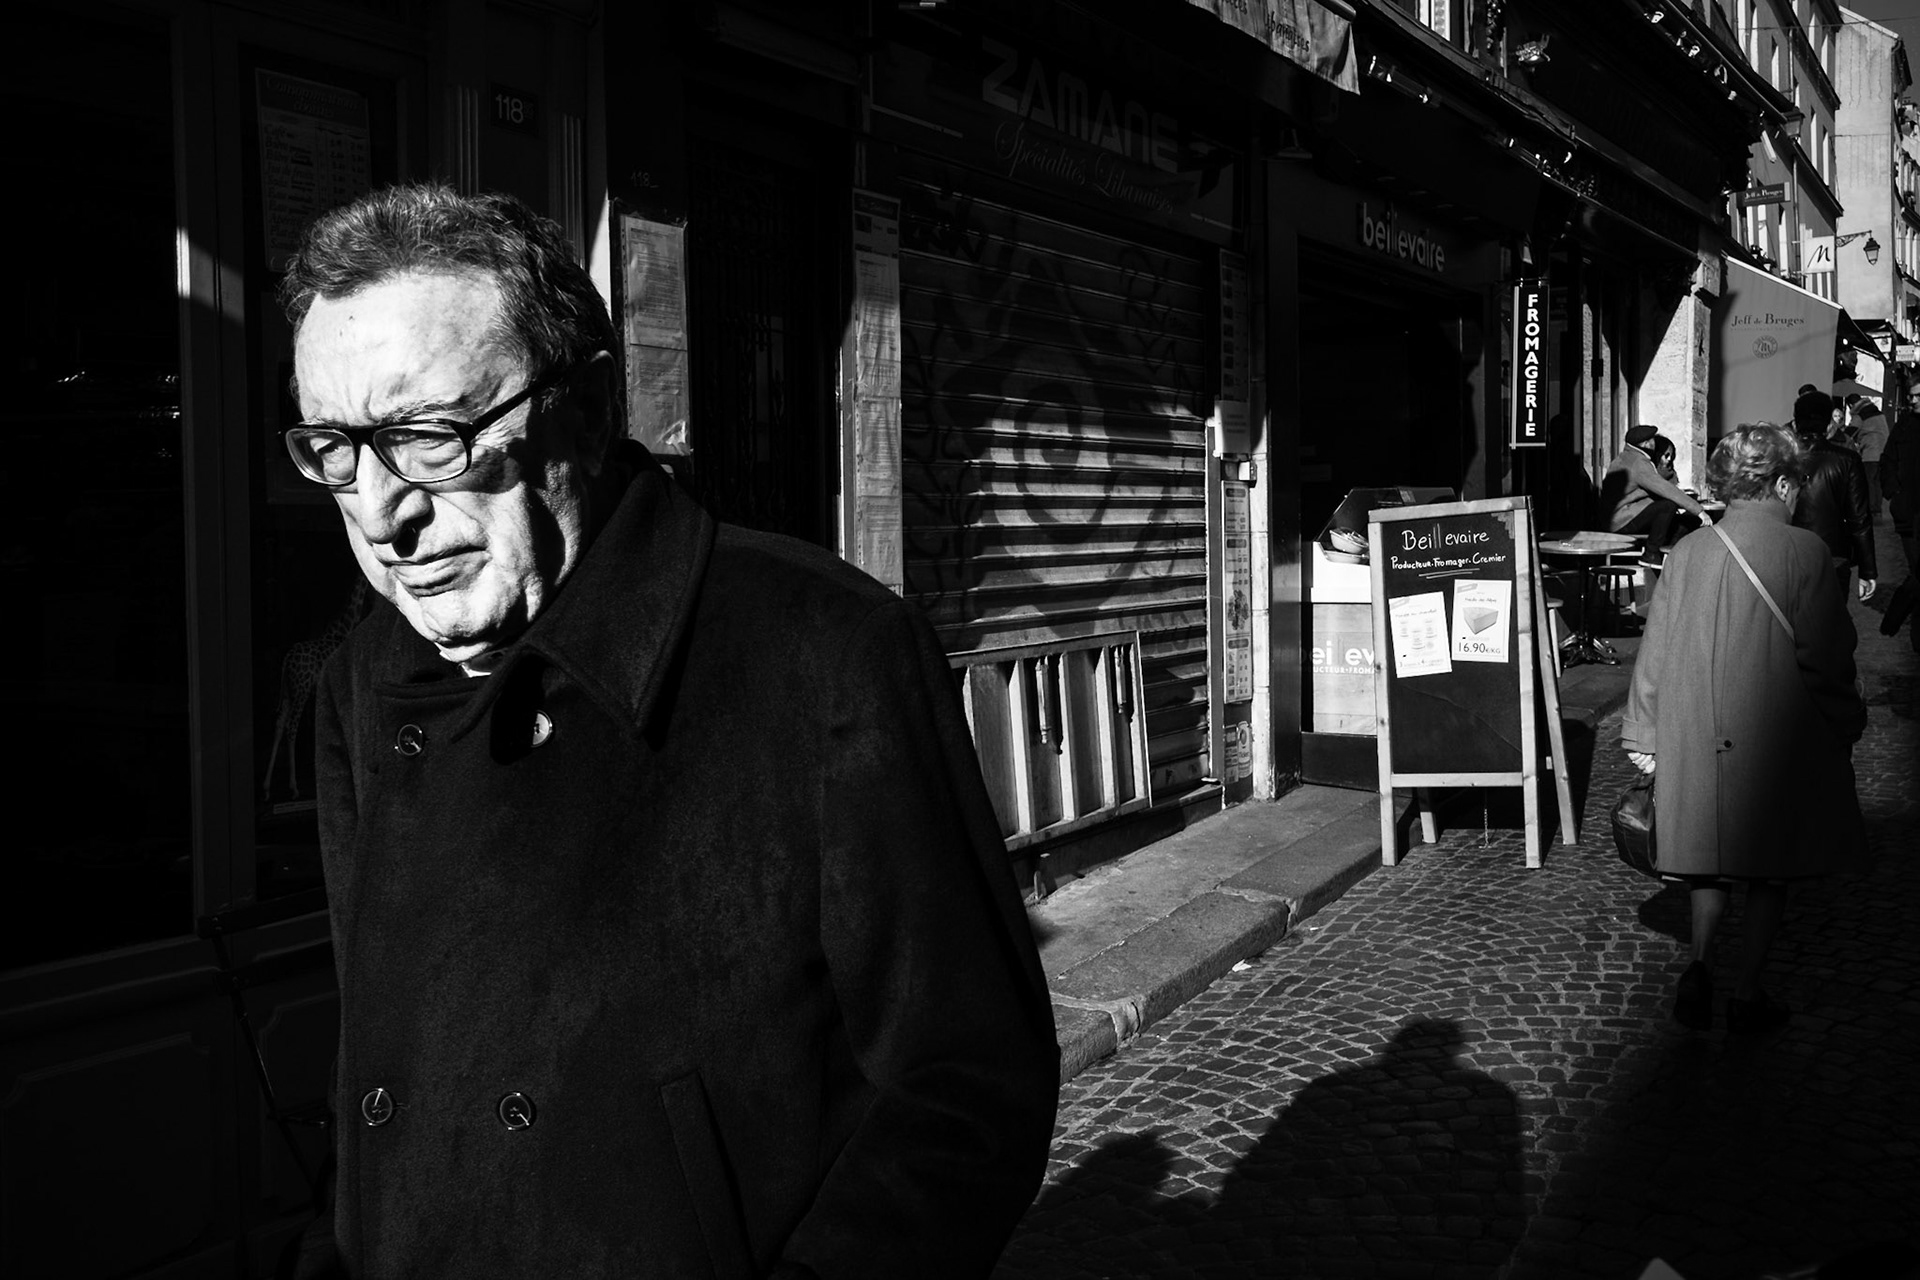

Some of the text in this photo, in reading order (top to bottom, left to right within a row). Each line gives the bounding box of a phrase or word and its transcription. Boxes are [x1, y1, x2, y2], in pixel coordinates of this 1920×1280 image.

[495, 92, 524, 125] 118
[981, 34, 1179, 175] ZAMANE
[1731, 315, 1753, 327] Jeff
[1764, 313, 1805, 328] Bruges
[1524, 293, 1541, 437] FROMAGERIE
